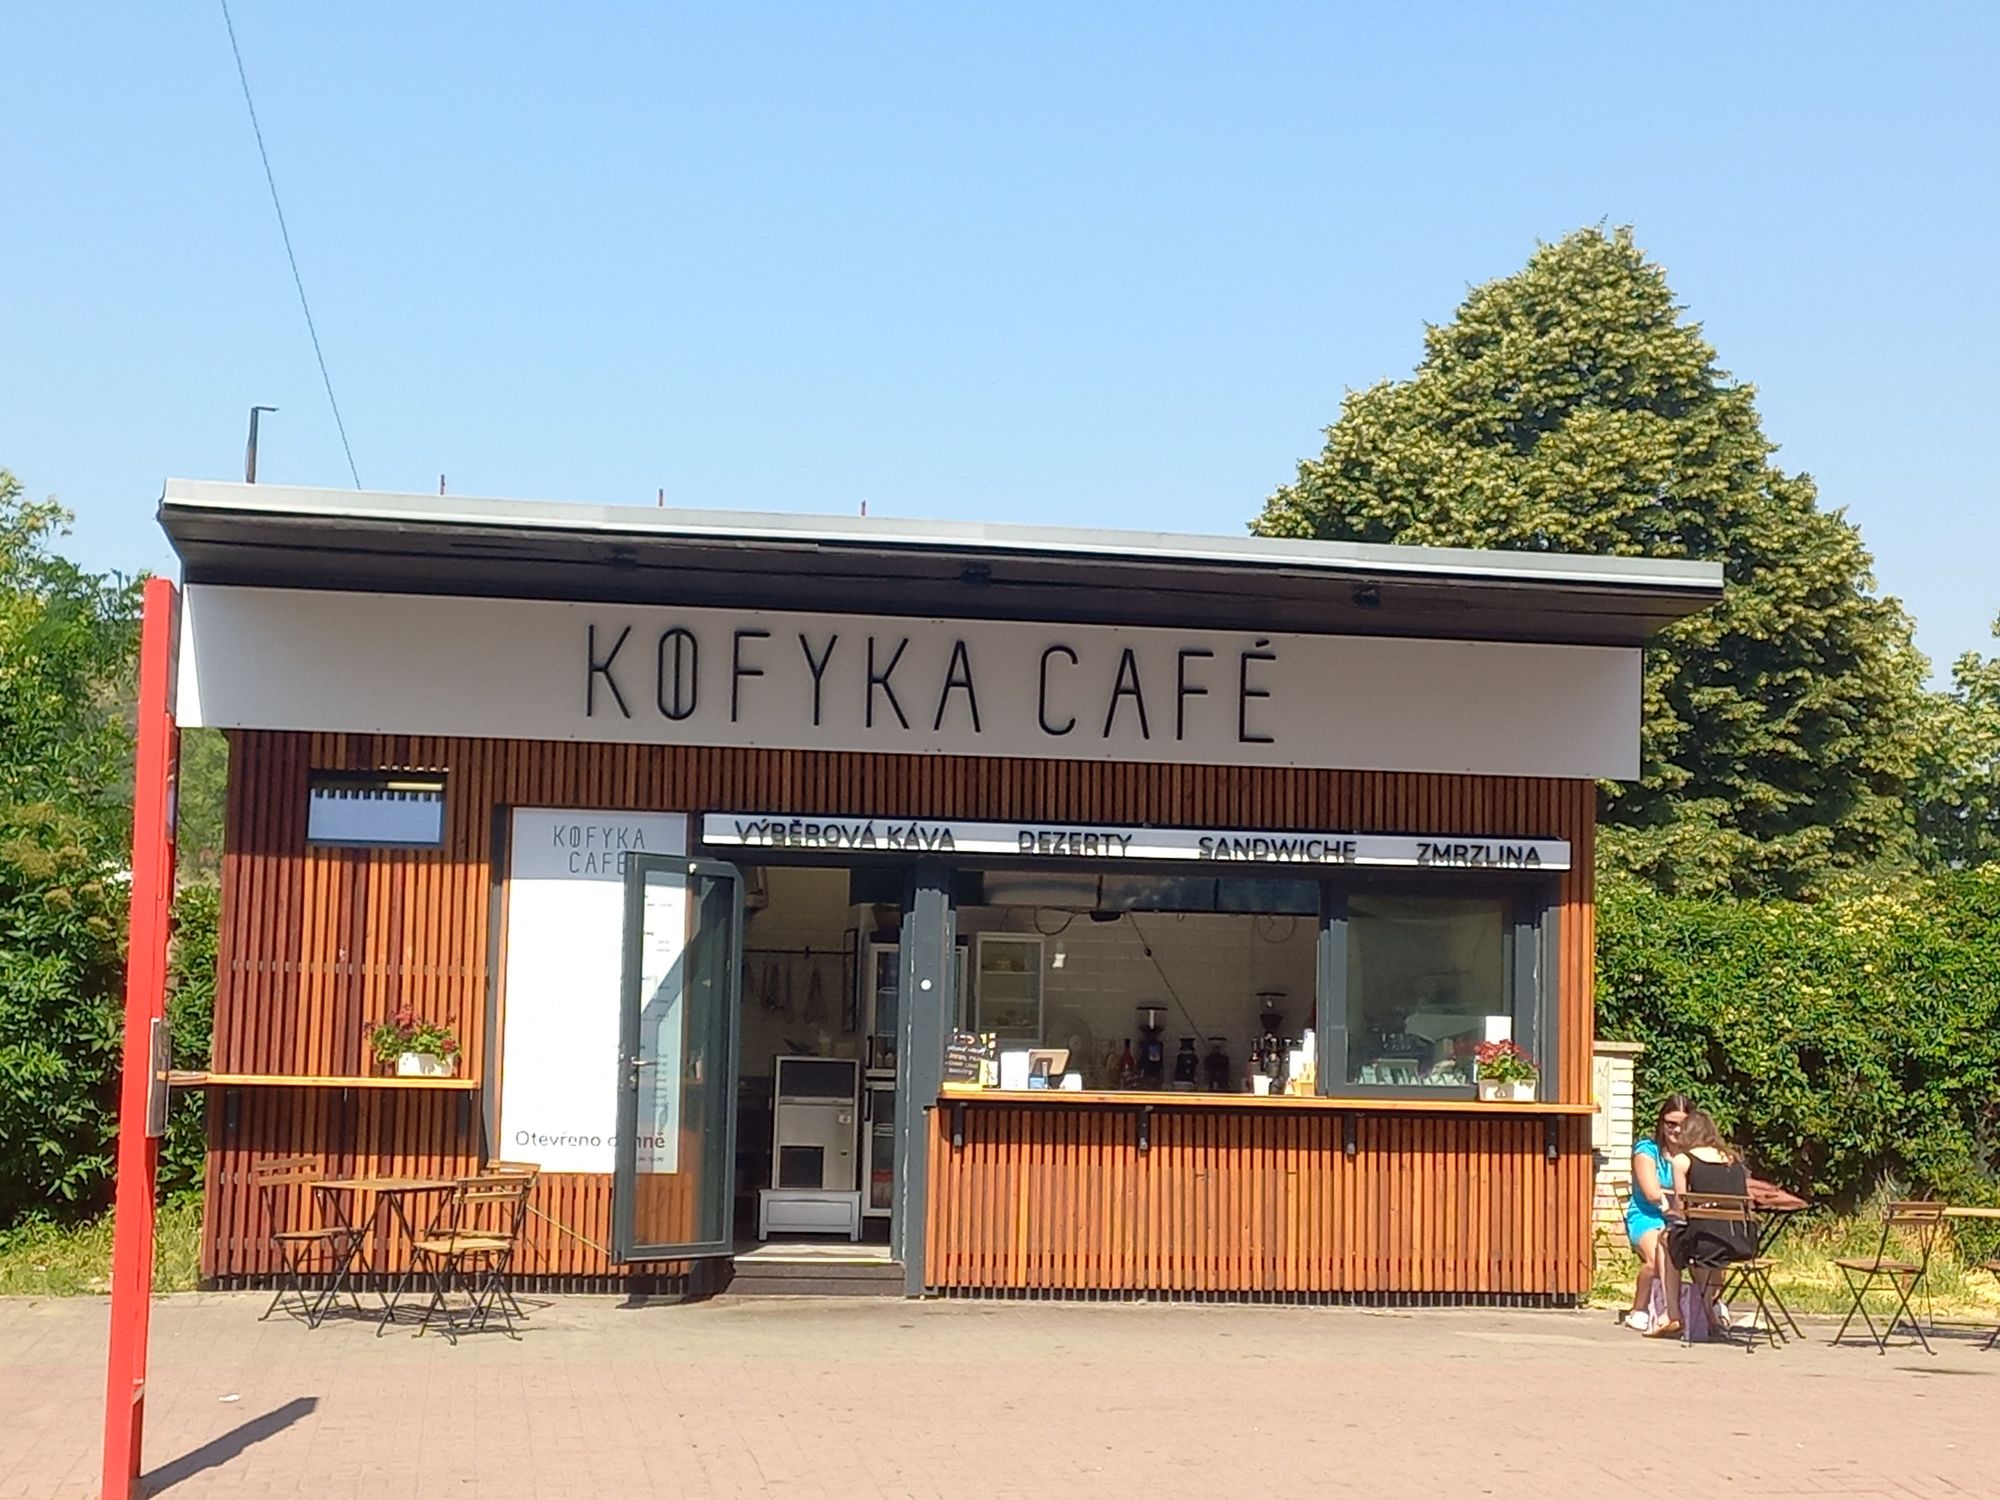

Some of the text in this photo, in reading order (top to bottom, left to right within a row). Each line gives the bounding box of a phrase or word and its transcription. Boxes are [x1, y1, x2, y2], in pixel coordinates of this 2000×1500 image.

[586, 624, 1277, 743] KOFYKA CAFÉ
[735, 819, 956, 850] VÝBĚROVÁ KÁVA
[1018, 830, 1132, 857] DEZERTY
[1198, 837, 1357, 863] SANDWICHE
[1416, 843, 1541, 868] ZMRZLINA
